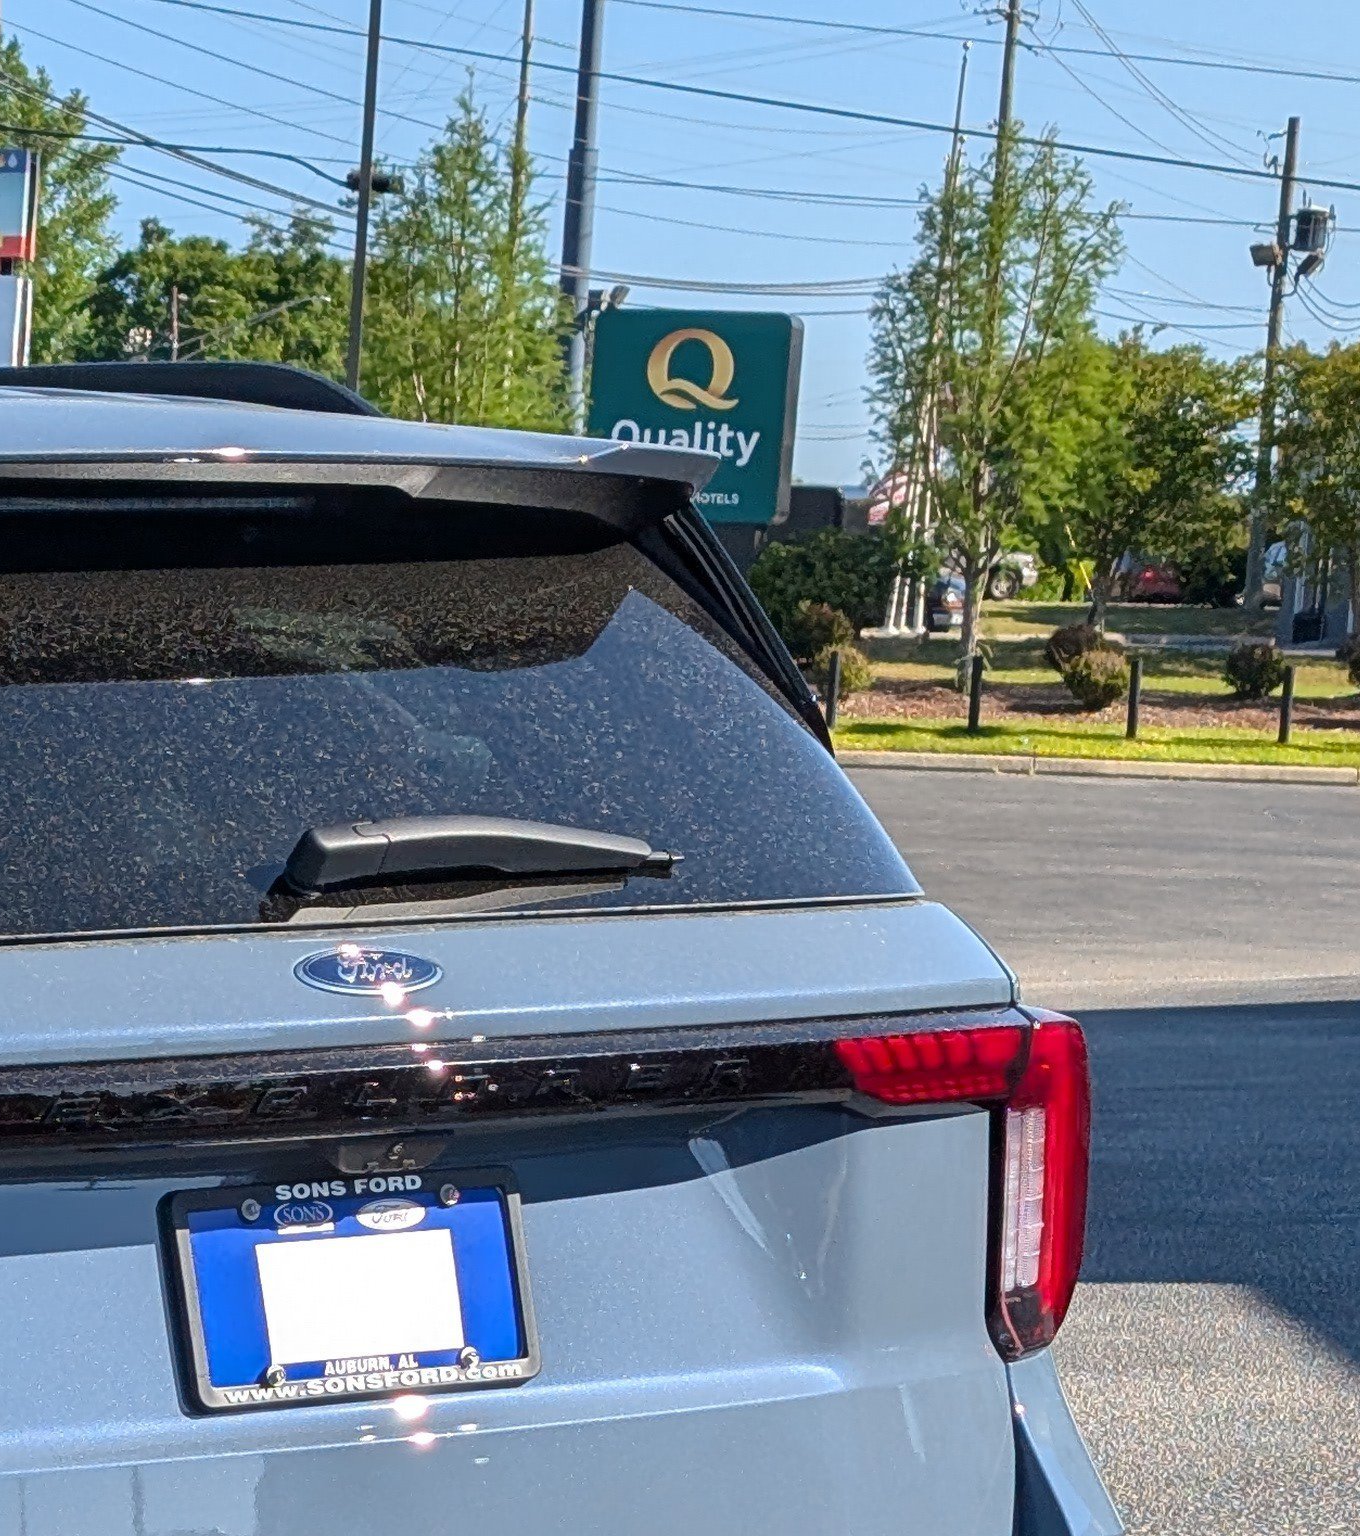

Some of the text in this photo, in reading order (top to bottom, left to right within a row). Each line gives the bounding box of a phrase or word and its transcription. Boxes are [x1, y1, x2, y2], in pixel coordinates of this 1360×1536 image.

[611, 418, 761, 467] Quality
[275, 1174, 423, 1201] SONS FORD
[282, 1203, 326, 1224] SONS
[324, 1354, 419, 1376] AUBURN, AL
[223, 1363, 523, 1404] www.SONSFORD.com
